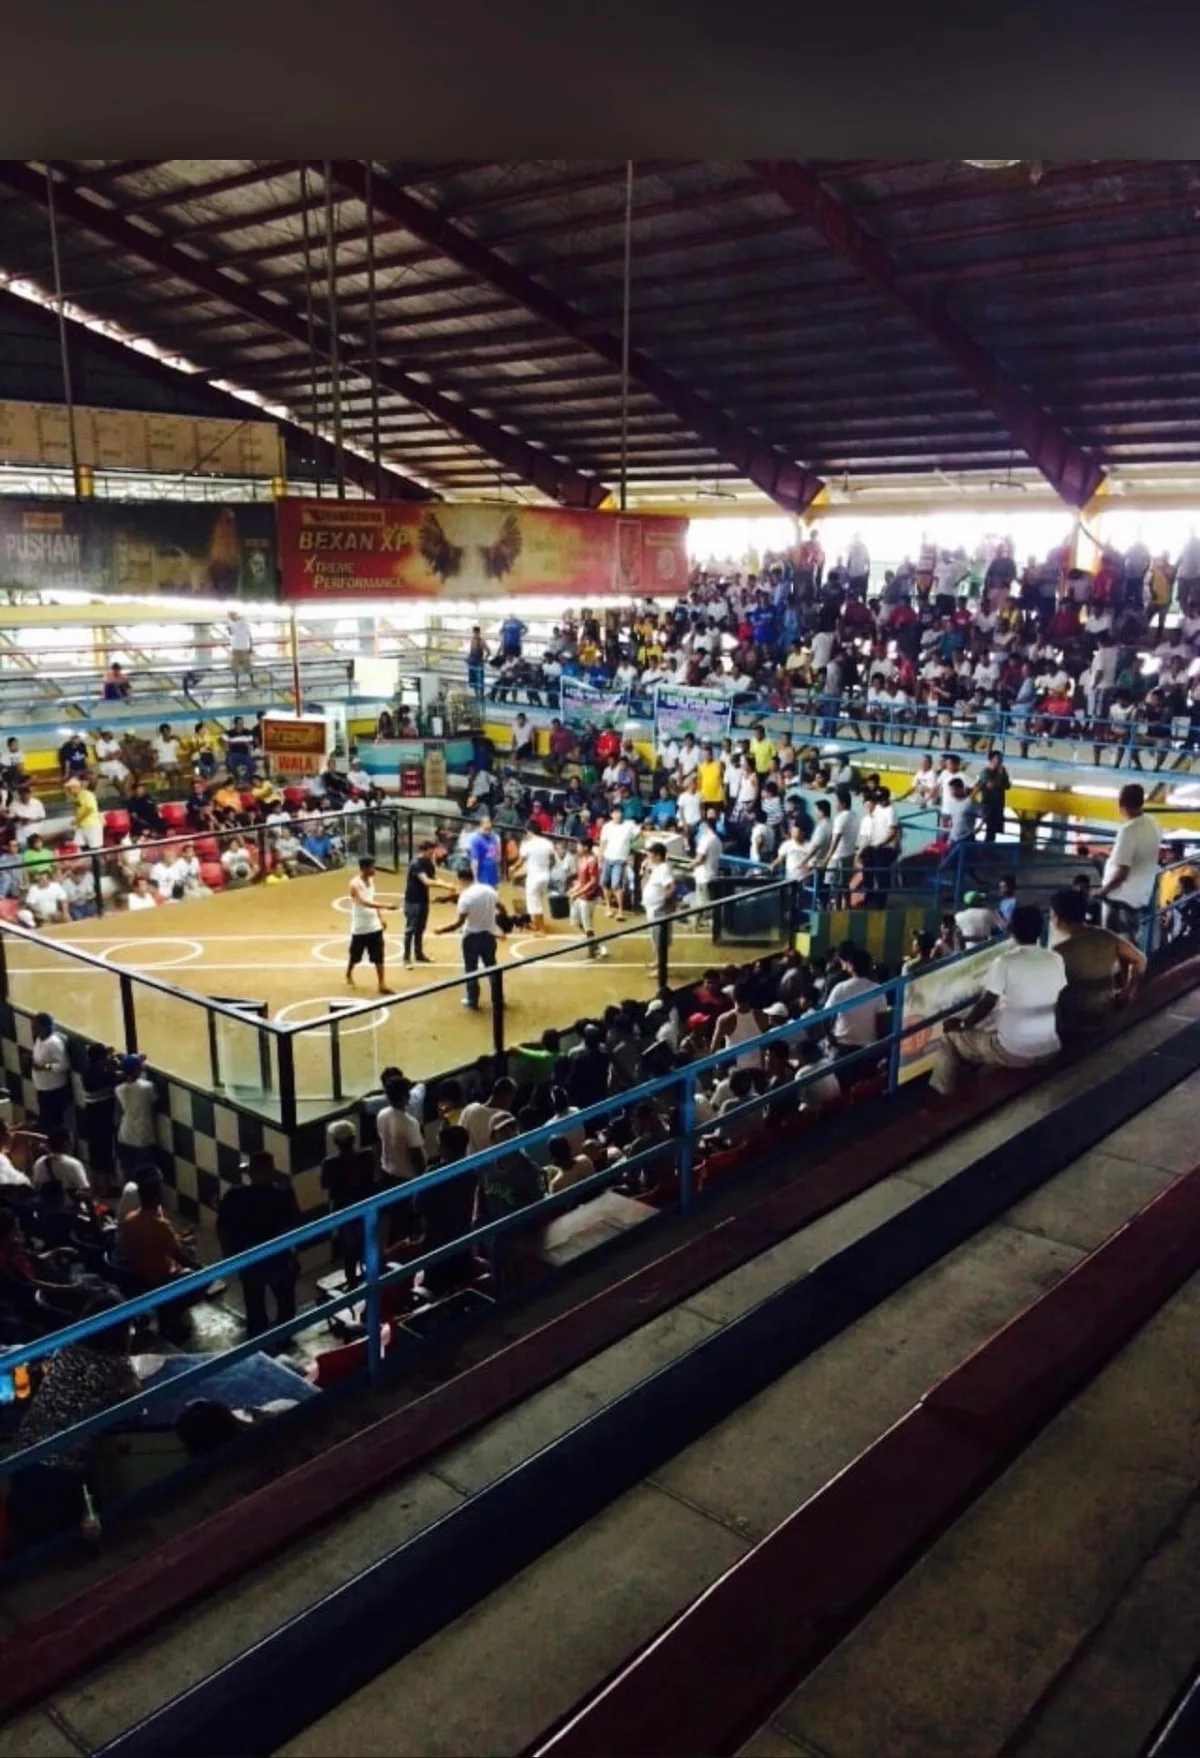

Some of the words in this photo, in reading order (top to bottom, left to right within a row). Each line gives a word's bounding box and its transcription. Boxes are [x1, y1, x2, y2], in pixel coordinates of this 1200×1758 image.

[300, 530, 374, 550] BEXAN
[380, 524, 409, 551] XP
[278, 755, 314, 771] WALA
